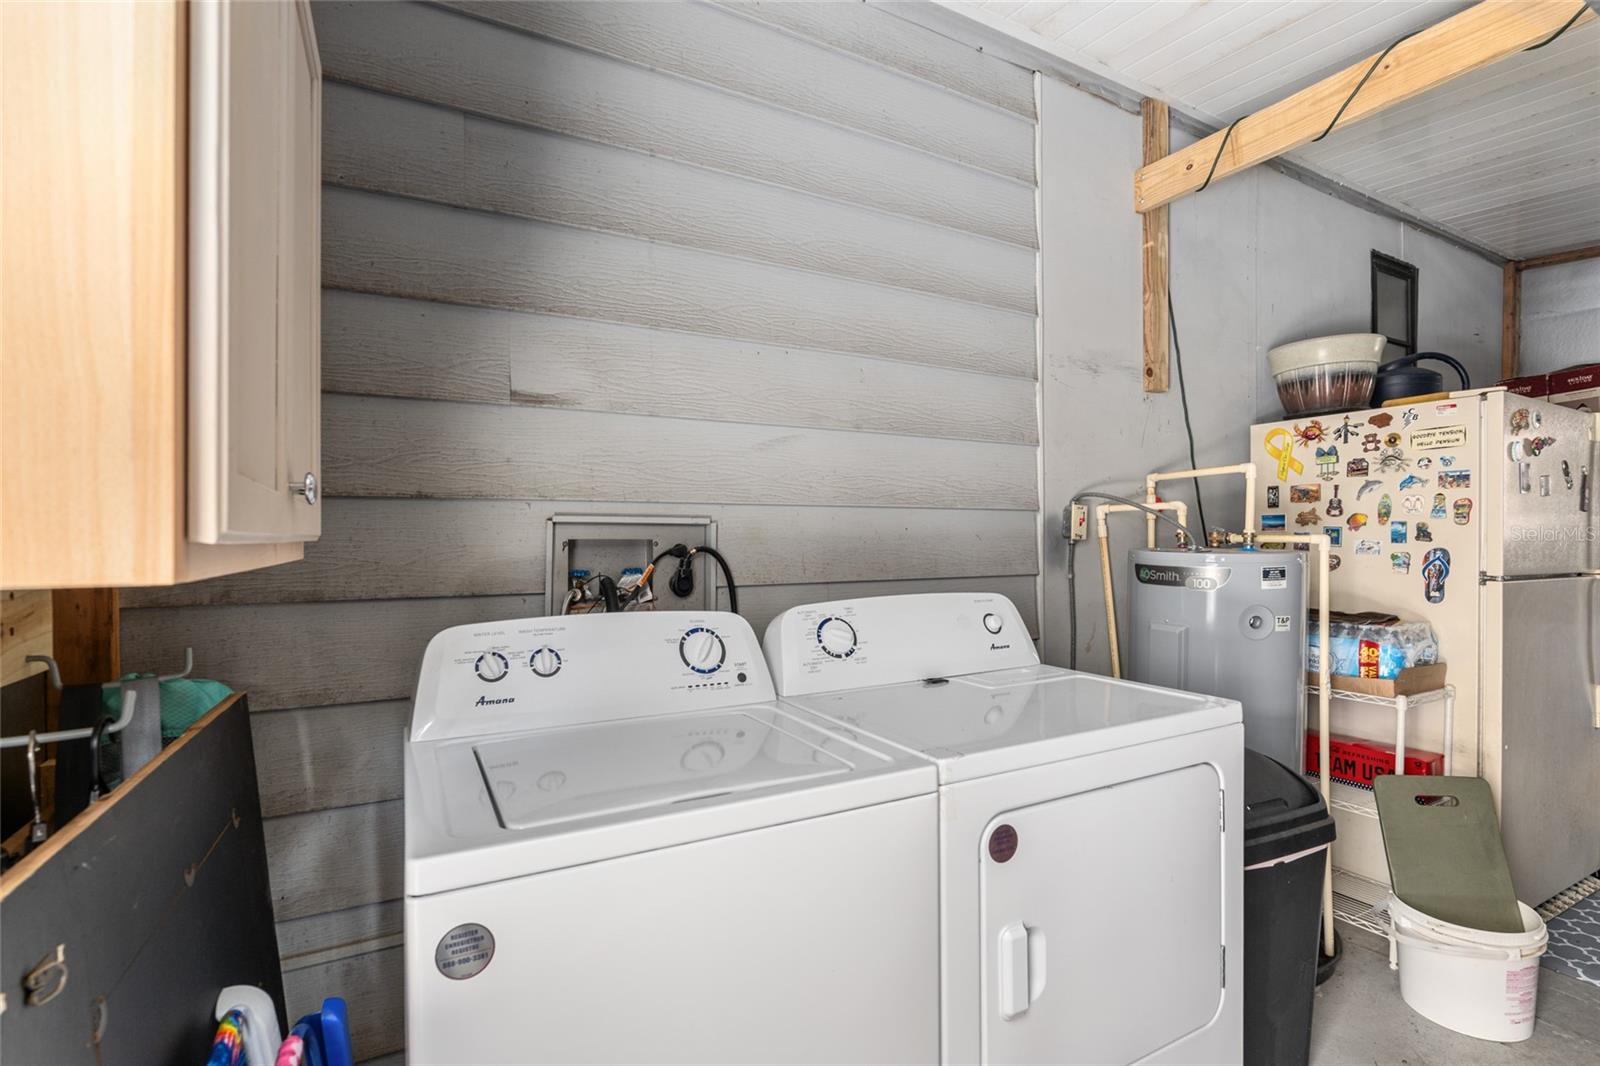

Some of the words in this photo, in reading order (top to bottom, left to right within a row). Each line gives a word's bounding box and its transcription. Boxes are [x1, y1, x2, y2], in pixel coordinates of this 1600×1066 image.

[1192, 578, 1211, 589] 100
[1277, 616, 1290, 624] T&P
[475, 695, 515, 707] Amana
